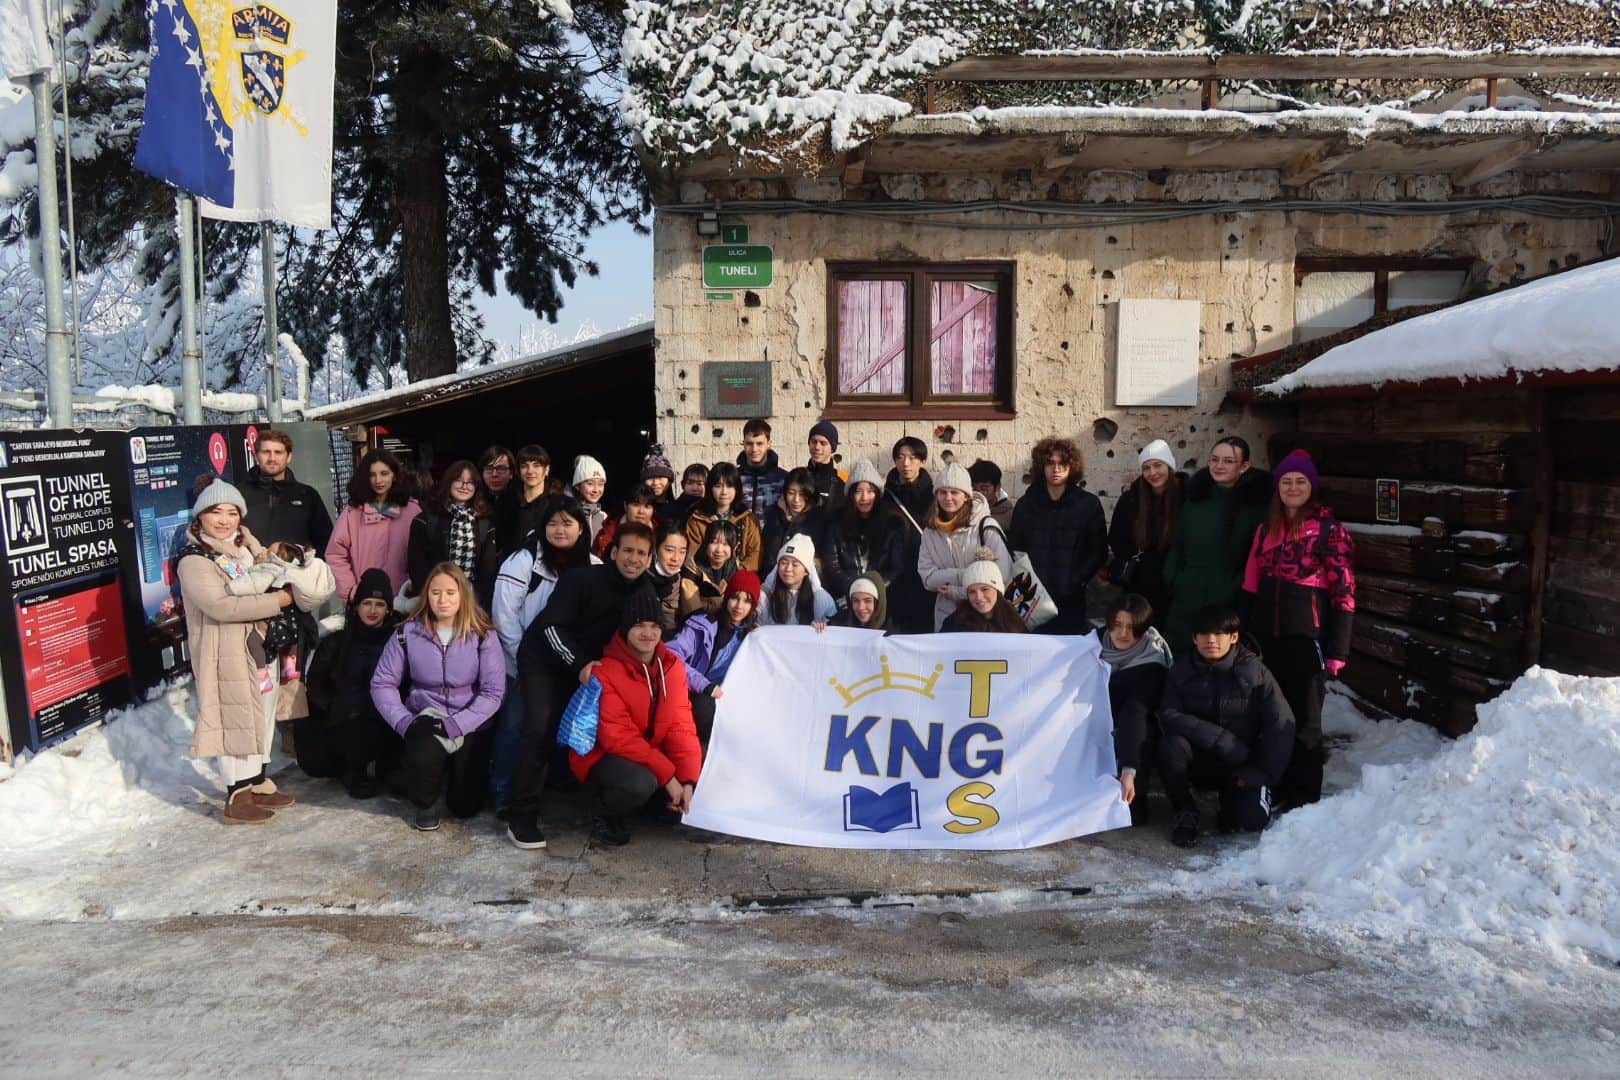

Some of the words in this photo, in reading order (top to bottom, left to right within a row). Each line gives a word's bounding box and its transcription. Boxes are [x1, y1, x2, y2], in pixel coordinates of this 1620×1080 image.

[233, 7, 288, 32] ARMIJA
[731, 229, 738, 241] 1
[46, 472, 110, 494] TUNNEL
[50, 494, 69, 512] OF
[73, 489, 112, 509] HOPE
[51, 512, 83, 523] MEMORIAL
[83, 507, 111, 518] COMPLEX
[53, 521, 96, 539] TUNNEL
[97, 517, 113, 531] D-B
[8, 549, 67, 577] TUNEL
[69, 538, 117, 563] SPASA
[55, 563, 90, 579] KOMPLEKS
[90, 559, 109, 570] TUNEL
